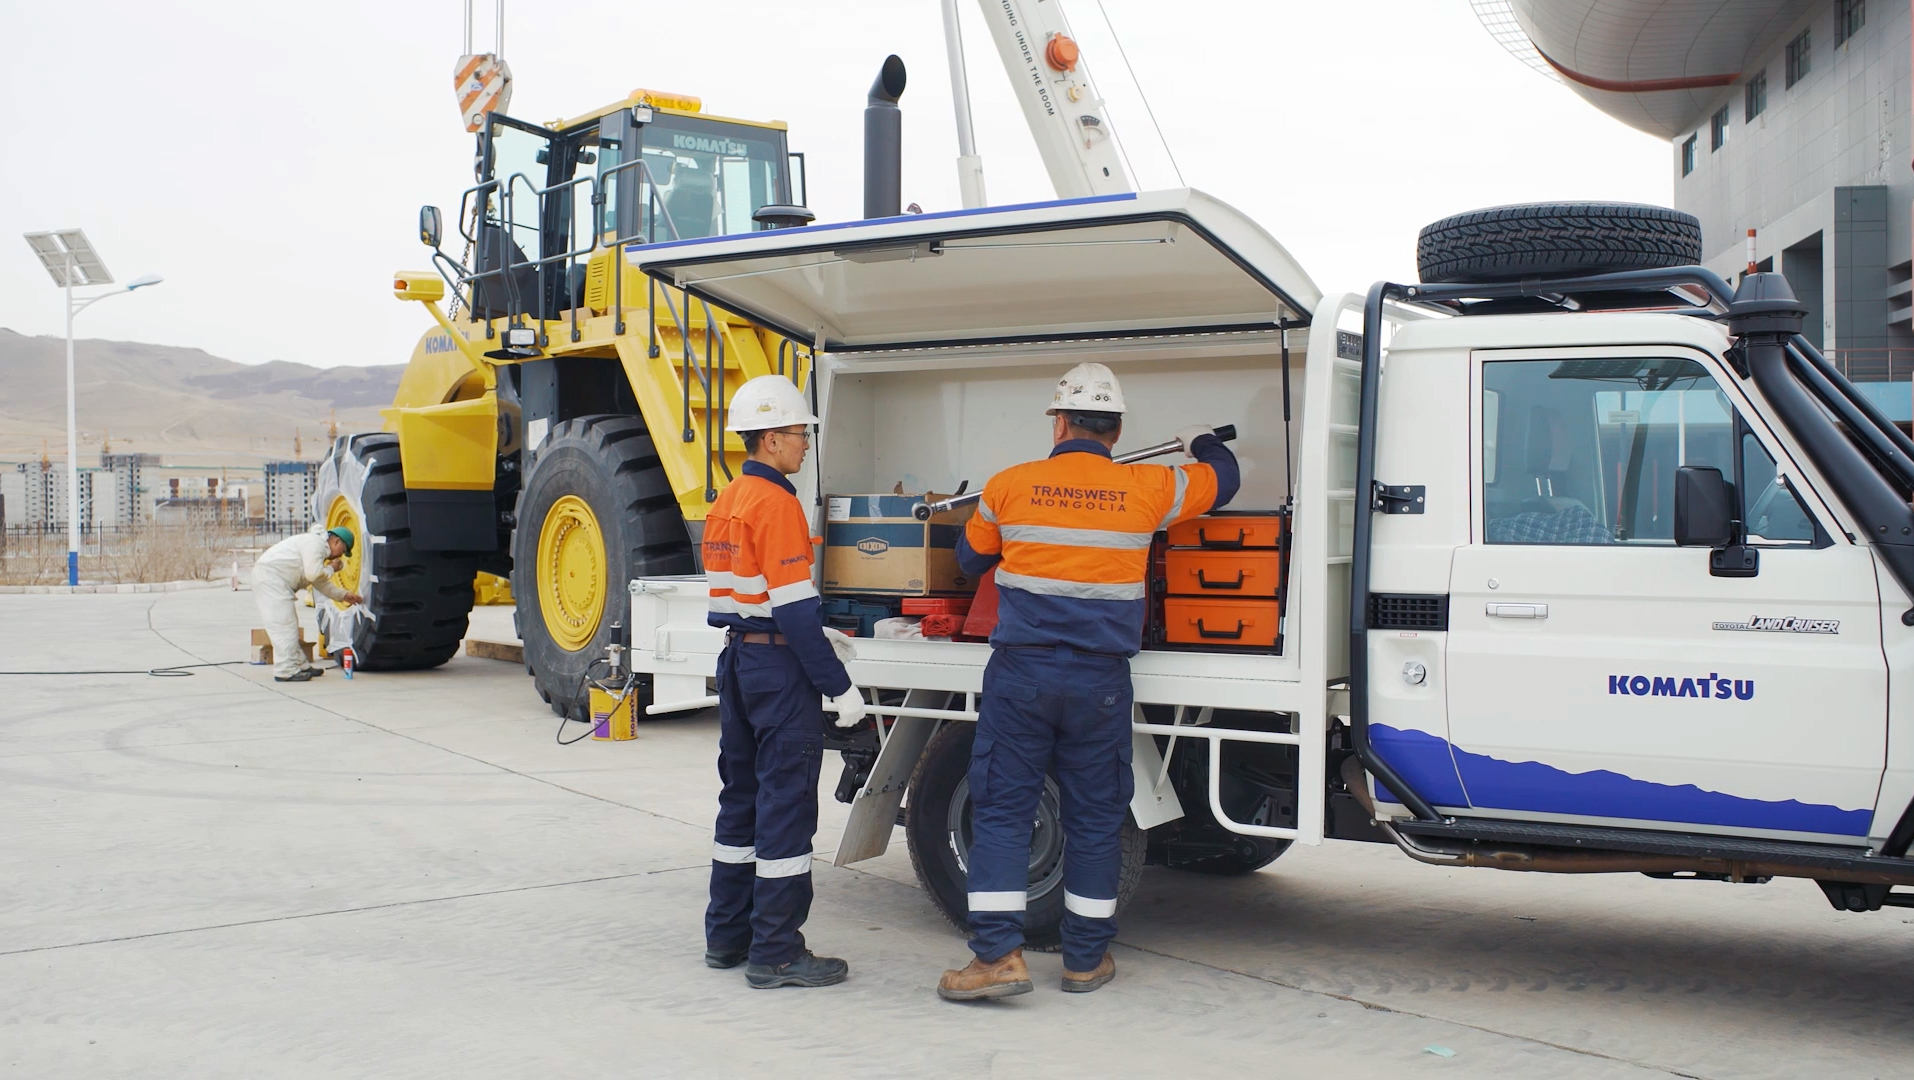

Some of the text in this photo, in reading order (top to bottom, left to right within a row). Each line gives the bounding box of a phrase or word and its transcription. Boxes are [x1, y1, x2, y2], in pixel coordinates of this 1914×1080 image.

[1015, 30, 1033, 64] UNDER
[1030, 66, 1042, 87] THE
[1038, 88, 1055, 117] BOOM
[673, 134, 747, 157] KOMATSU
[1032, 485, 1127, 502] TRANSWEST
[1030, 498, 1126, 512] MONGOLIA
[859, 541, 887, 552] DIXON
[1608, 672, 1754, 701] KOMATSU
